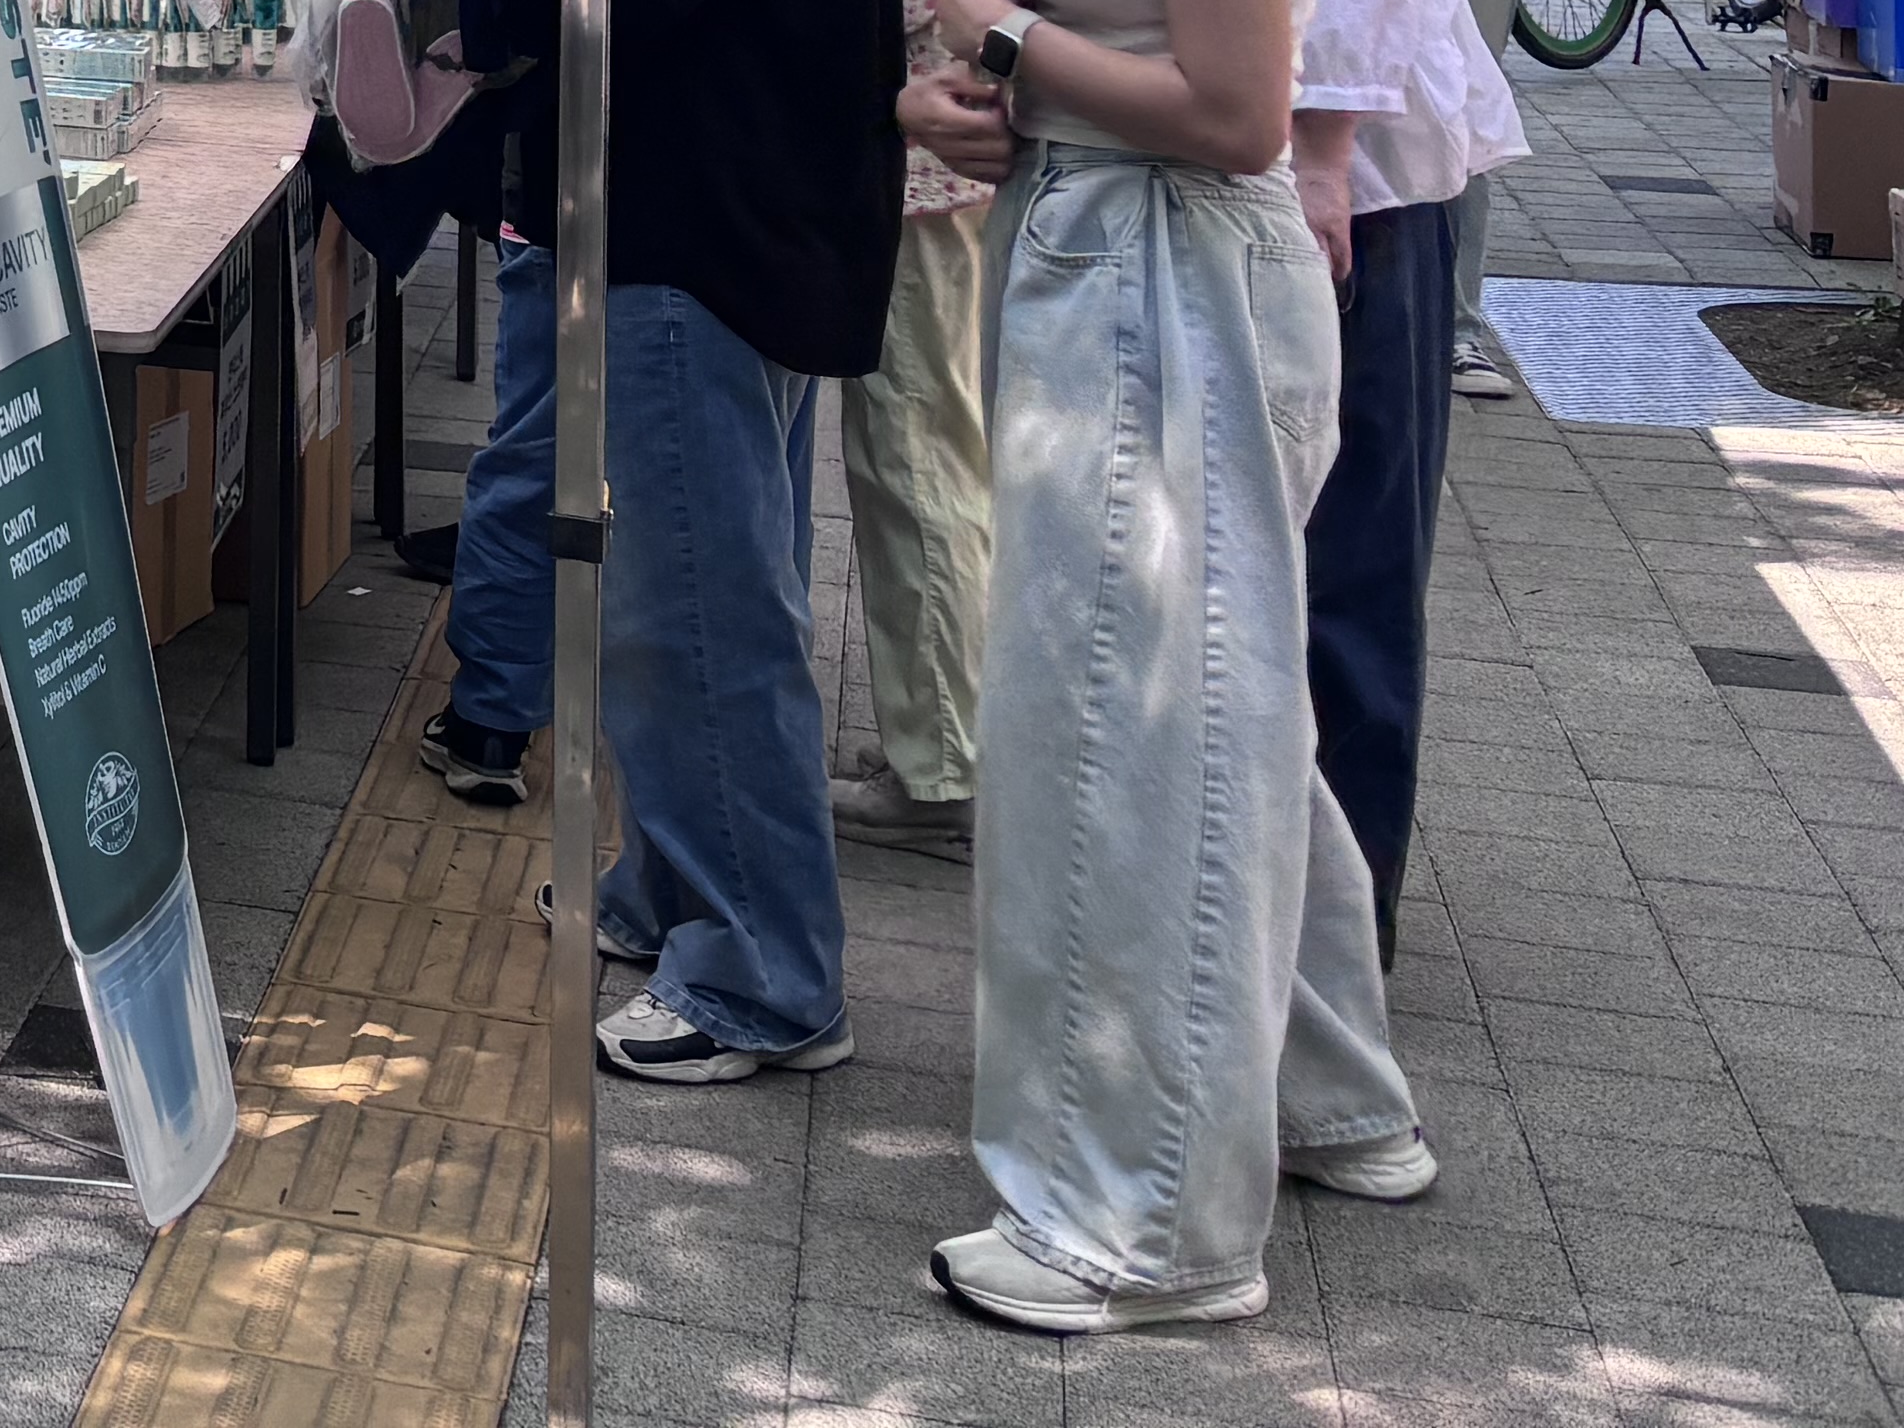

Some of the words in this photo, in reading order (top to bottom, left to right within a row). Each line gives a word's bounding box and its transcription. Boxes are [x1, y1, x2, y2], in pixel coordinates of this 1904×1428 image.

[2, 504, 37, 547] CAVITY
[8, 521, 71, 580] PROTECTION
[21, 594, 54, 629] Fluoride
[27, 626, 57, 659] Breath
[53, 615, 74, 641] Care
[34, 652, 63, 689] Natural
[61, 633, 89, 669] Herbal
[86, 615, 117, 650] Extracts
[63, 680, 73, 702] &
[69, 661, 101, 697] Vitamin
[97, 653, 107, 676] C
